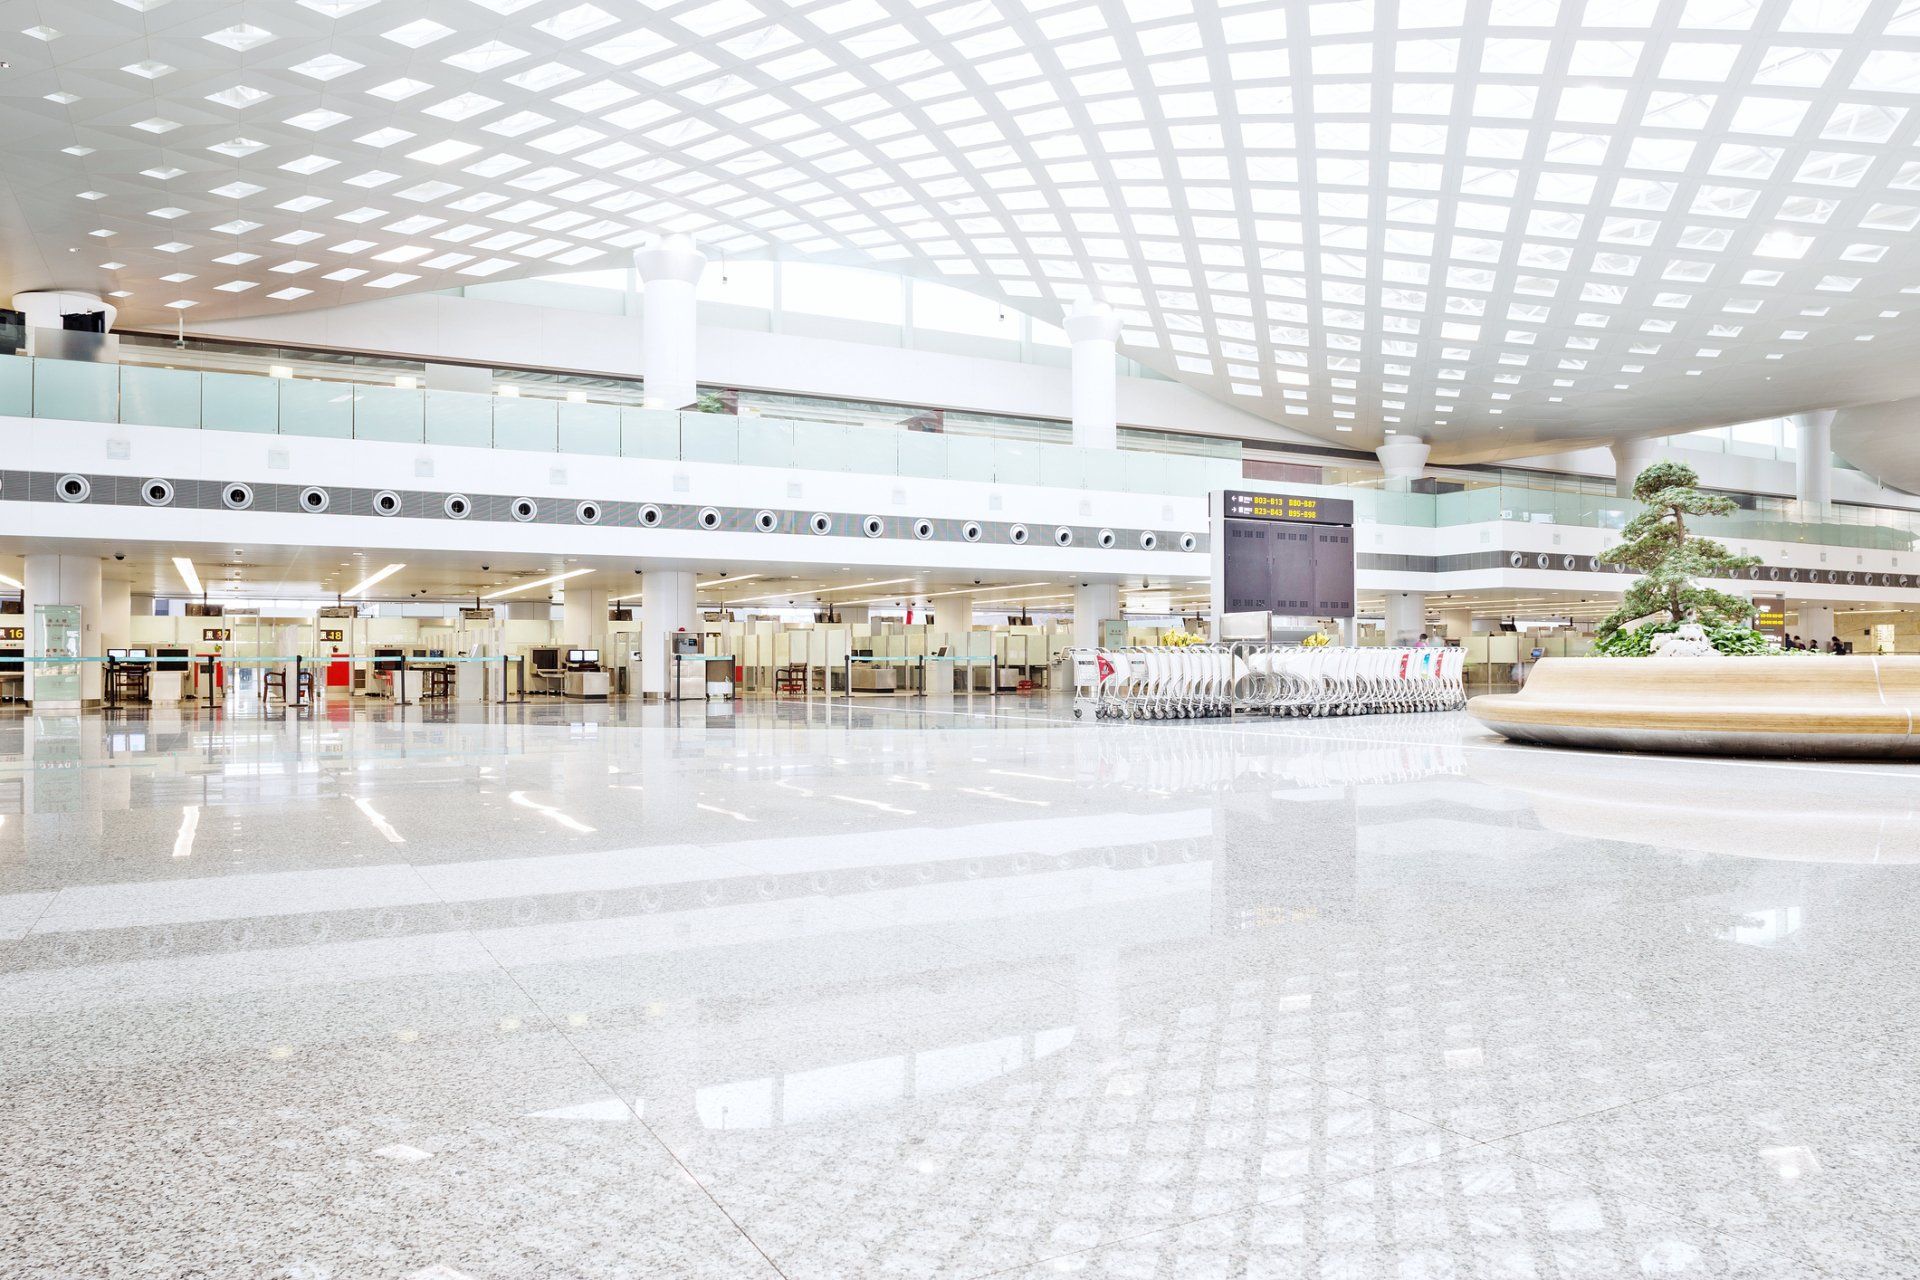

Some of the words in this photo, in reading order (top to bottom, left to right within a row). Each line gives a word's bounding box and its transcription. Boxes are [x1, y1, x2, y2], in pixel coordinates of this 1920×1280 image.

[1254, 496, 1283, 505] B03-B13
[1254, 507, 1283, 516] B23-B43
[9, 629, 23, 638] 16
[330, 631, 341, 639] 18
